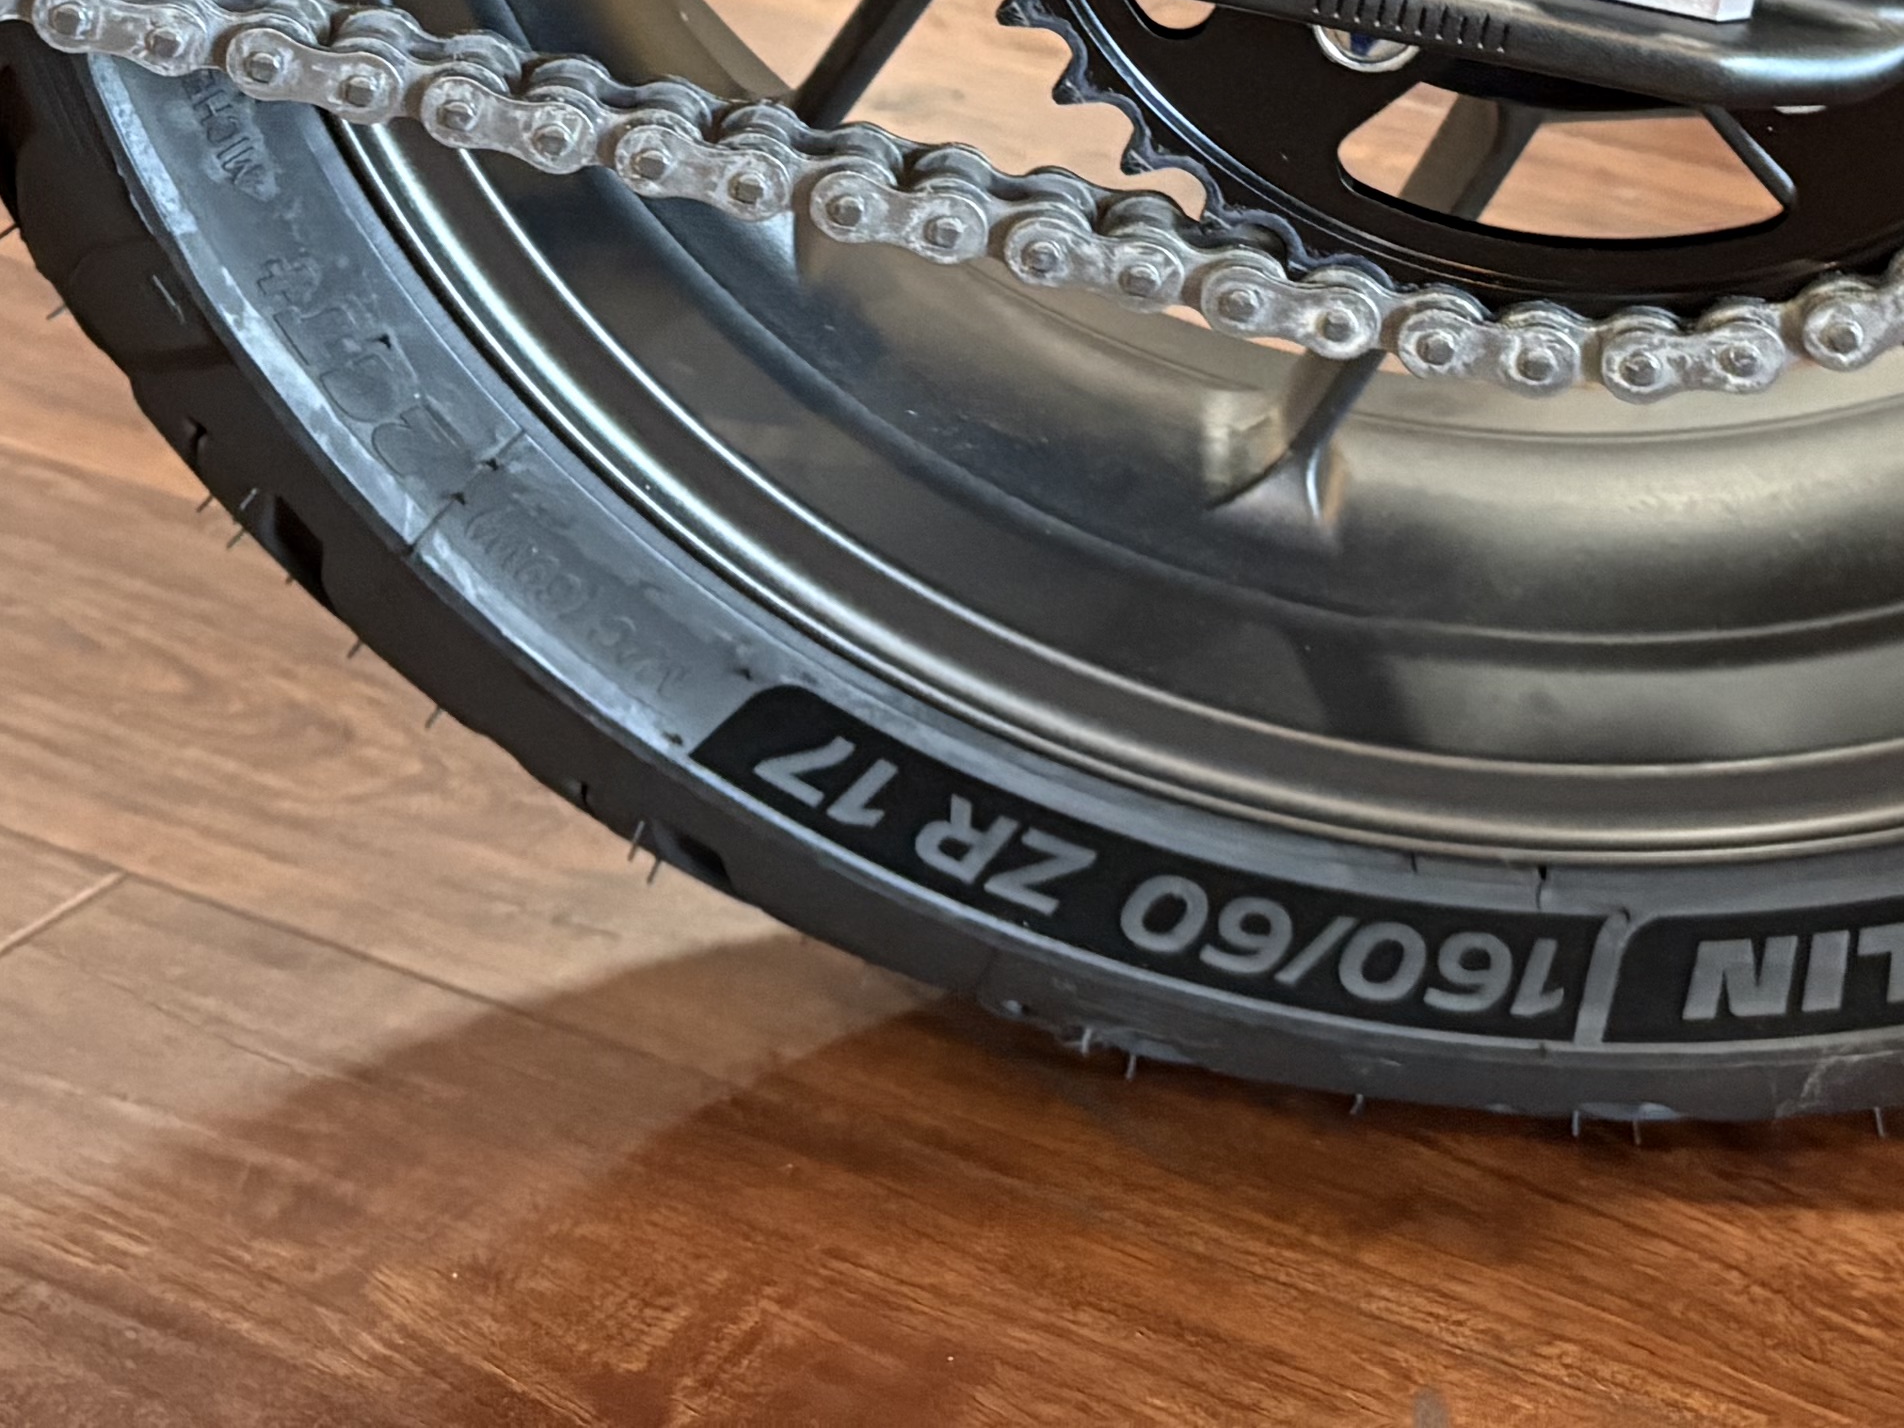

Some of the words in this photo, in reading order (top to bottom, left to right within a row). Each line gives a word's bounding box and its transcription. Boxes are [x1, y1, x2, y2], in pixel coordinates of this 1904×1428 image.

[187, 72, 280, 198] MICHE
[754, 736, 906, 830] 17
[913, 795, 1096, 915] ZR
[1119, 874, 1566, 1017] 160/60
